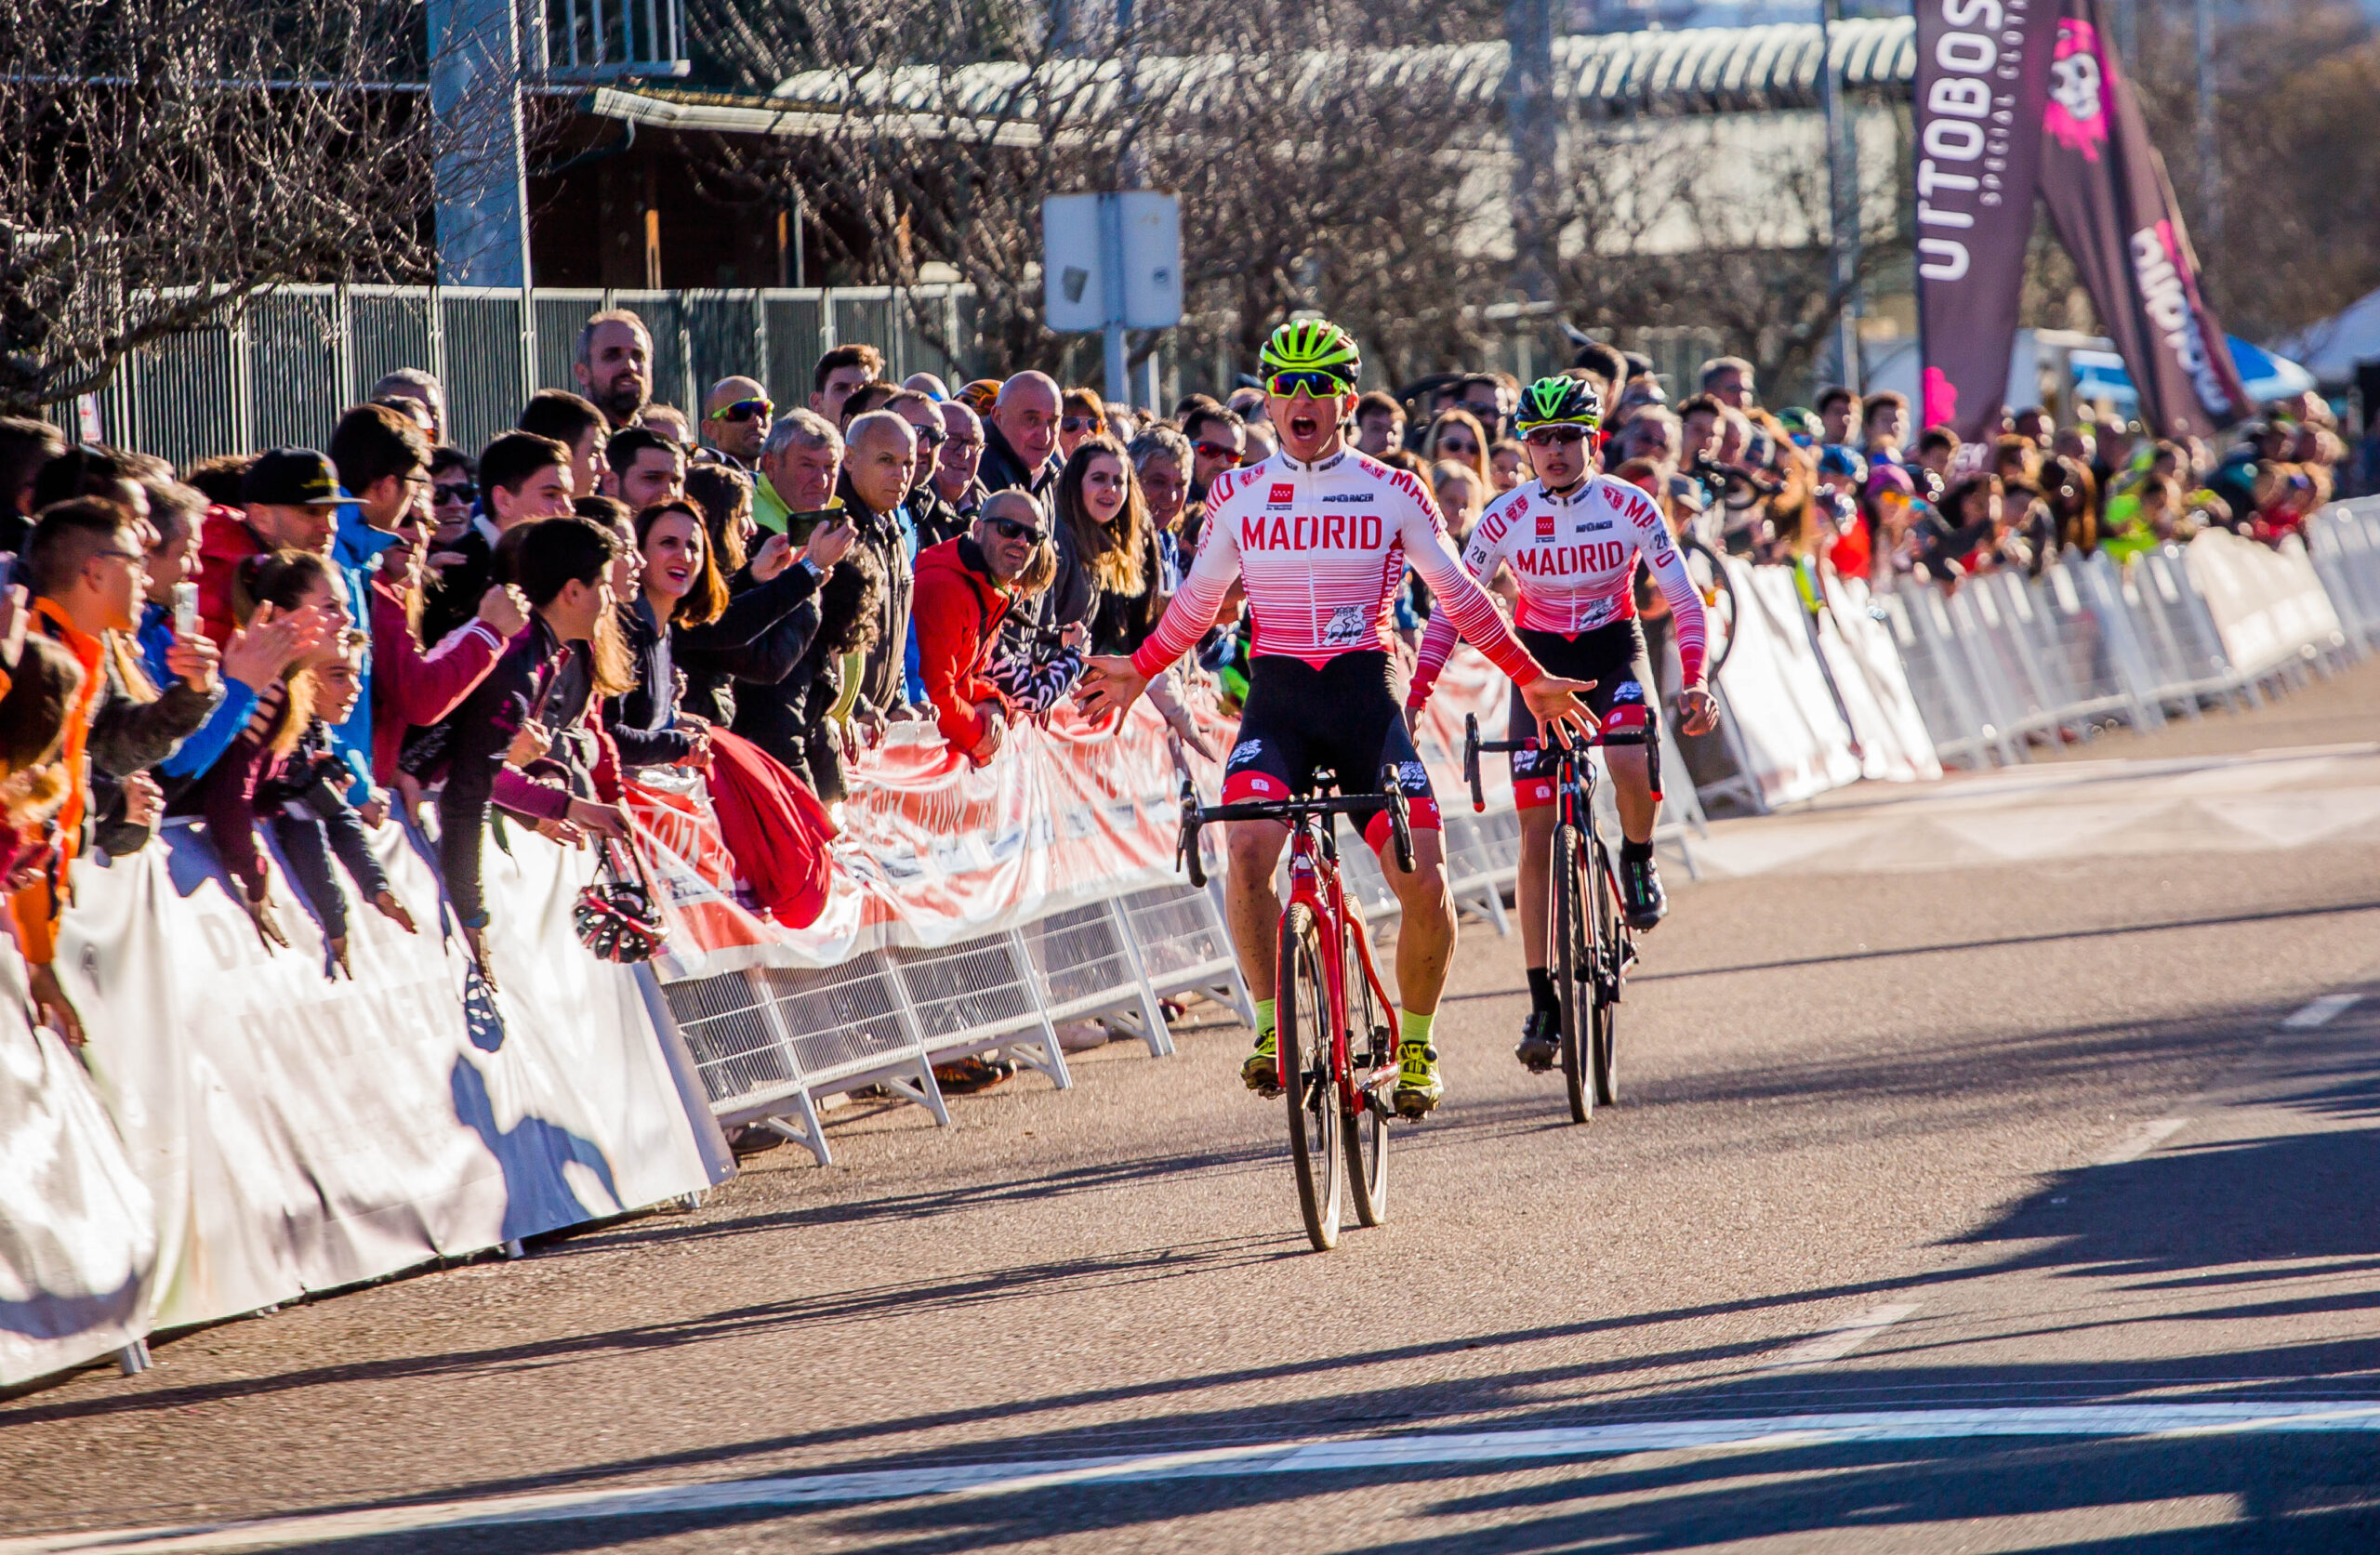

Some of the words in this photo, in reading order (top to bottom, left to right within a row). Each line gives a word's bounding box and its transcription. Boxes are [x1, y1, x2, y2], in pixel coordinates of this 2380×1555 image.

[1241, 515, 1382, 551] MADRID
[1471, 546, 1488, 564] 28
[1516, 540, 1624, 576] MADRID
